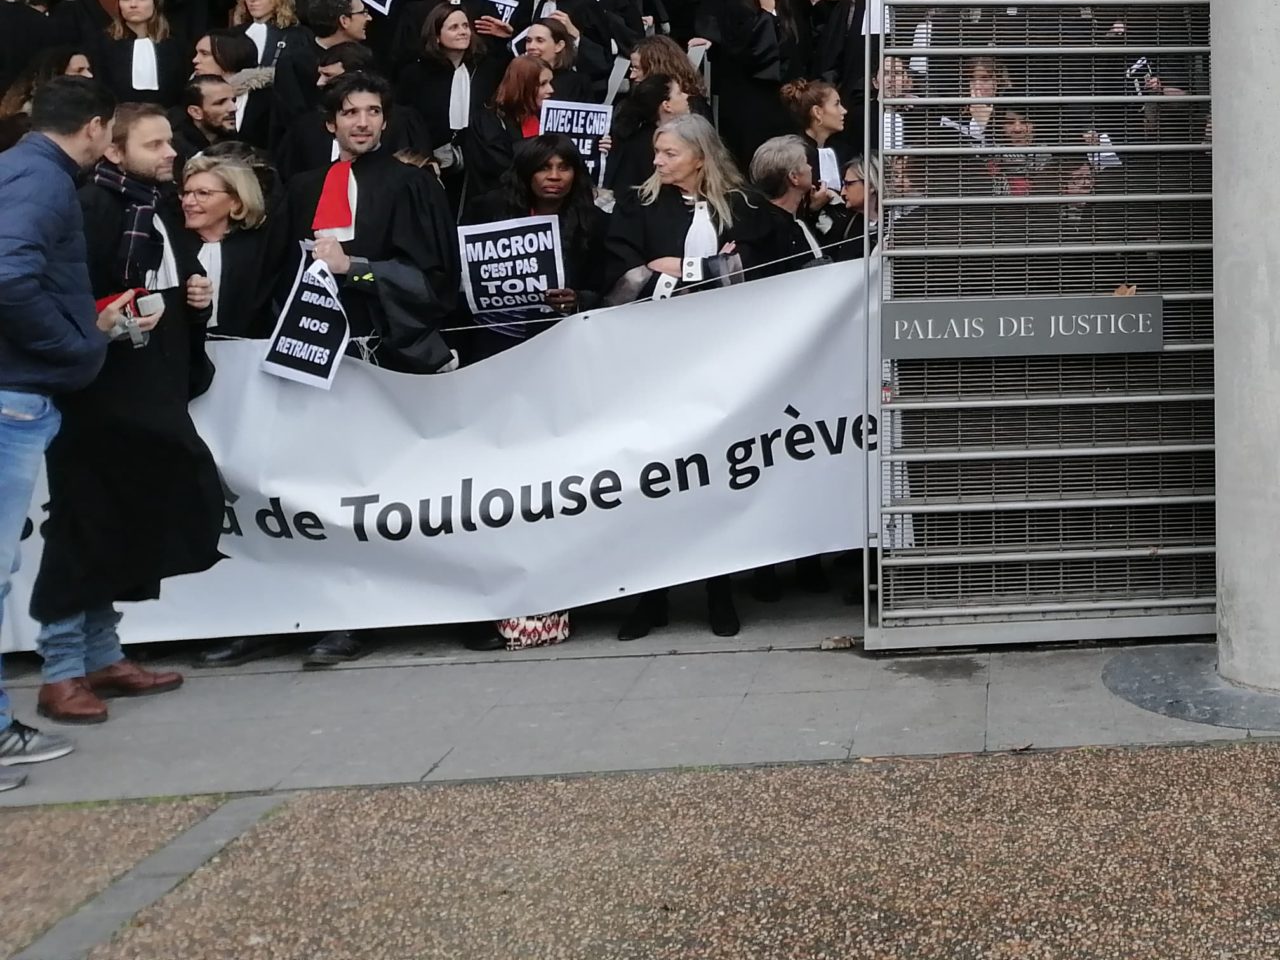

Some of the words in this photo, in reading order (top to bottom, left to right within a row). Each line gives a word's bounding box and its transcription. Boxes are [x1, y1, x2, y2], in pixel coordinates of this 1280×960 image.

[545, 109, 572, 133] AVEC
[572, 111, 586, 134] LE
[586, 112, 607, 136] CNB
[466, 230, 553, 262] MACRON
[480, 261, 514, 279] C'EST
[515, 257, 539, 275] PAS
[480, 275, 548, 294] TON
[298, 316, 330, 334] NOS
[894, 316, 985, 340] PALAIS
[997, 316, 1036, 338] DE
[1050, 312, 1153, 338] JUSTICE
[275, 336, 330, 366] RETRAITES
[254, 496, 328, 541] de
[339, 468, 623, 542] Toulouse
[638, 452, 711, 499] en
[725, 403, 878, 491] grève
